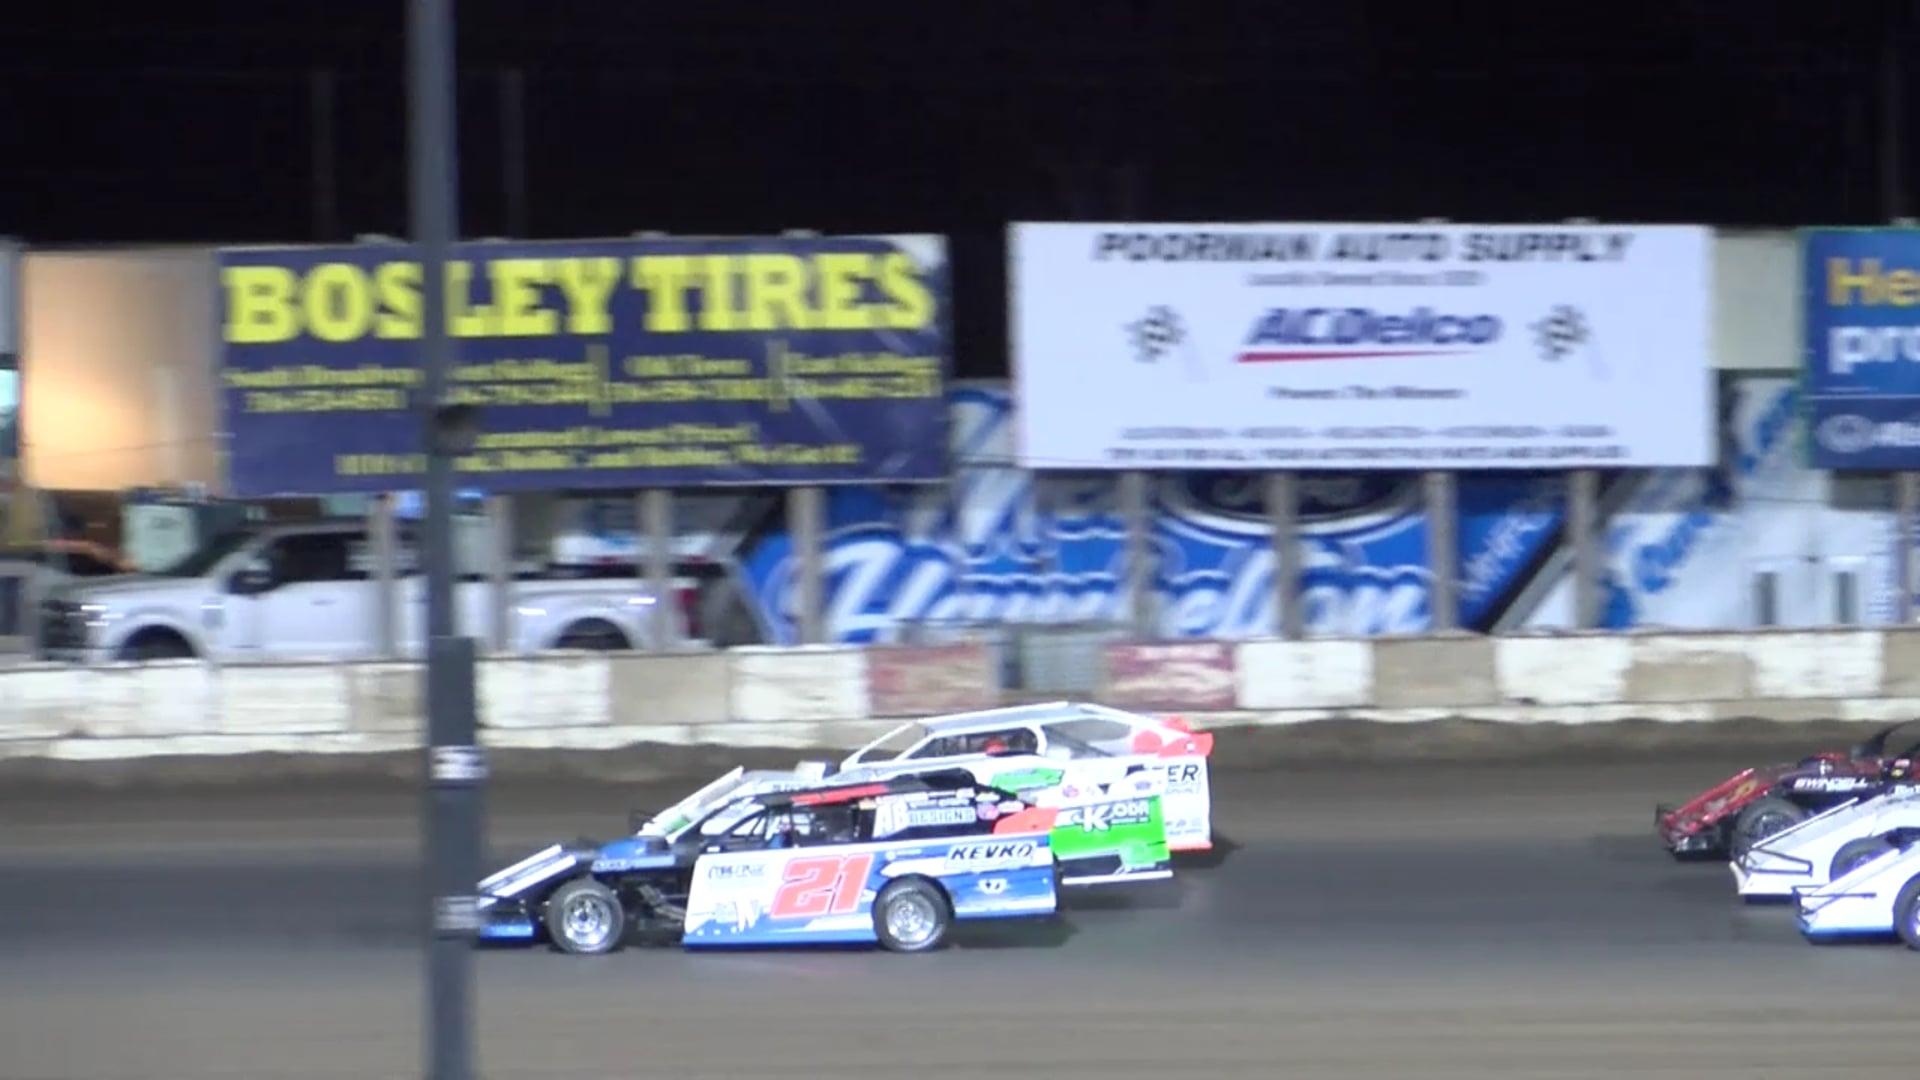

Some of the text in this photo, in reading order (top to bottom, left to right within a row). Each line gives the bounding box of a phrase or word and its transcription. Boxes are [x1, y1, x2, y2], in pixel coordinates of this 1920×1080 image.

[1094, 232, 1633, 262] POORMAN AUTO SUPPLY
[222, 252, 935, 342] BOSLEY TIRES
[951, 842, 1034, 861] KEVKO
[771, 851, 875, 919] 21
